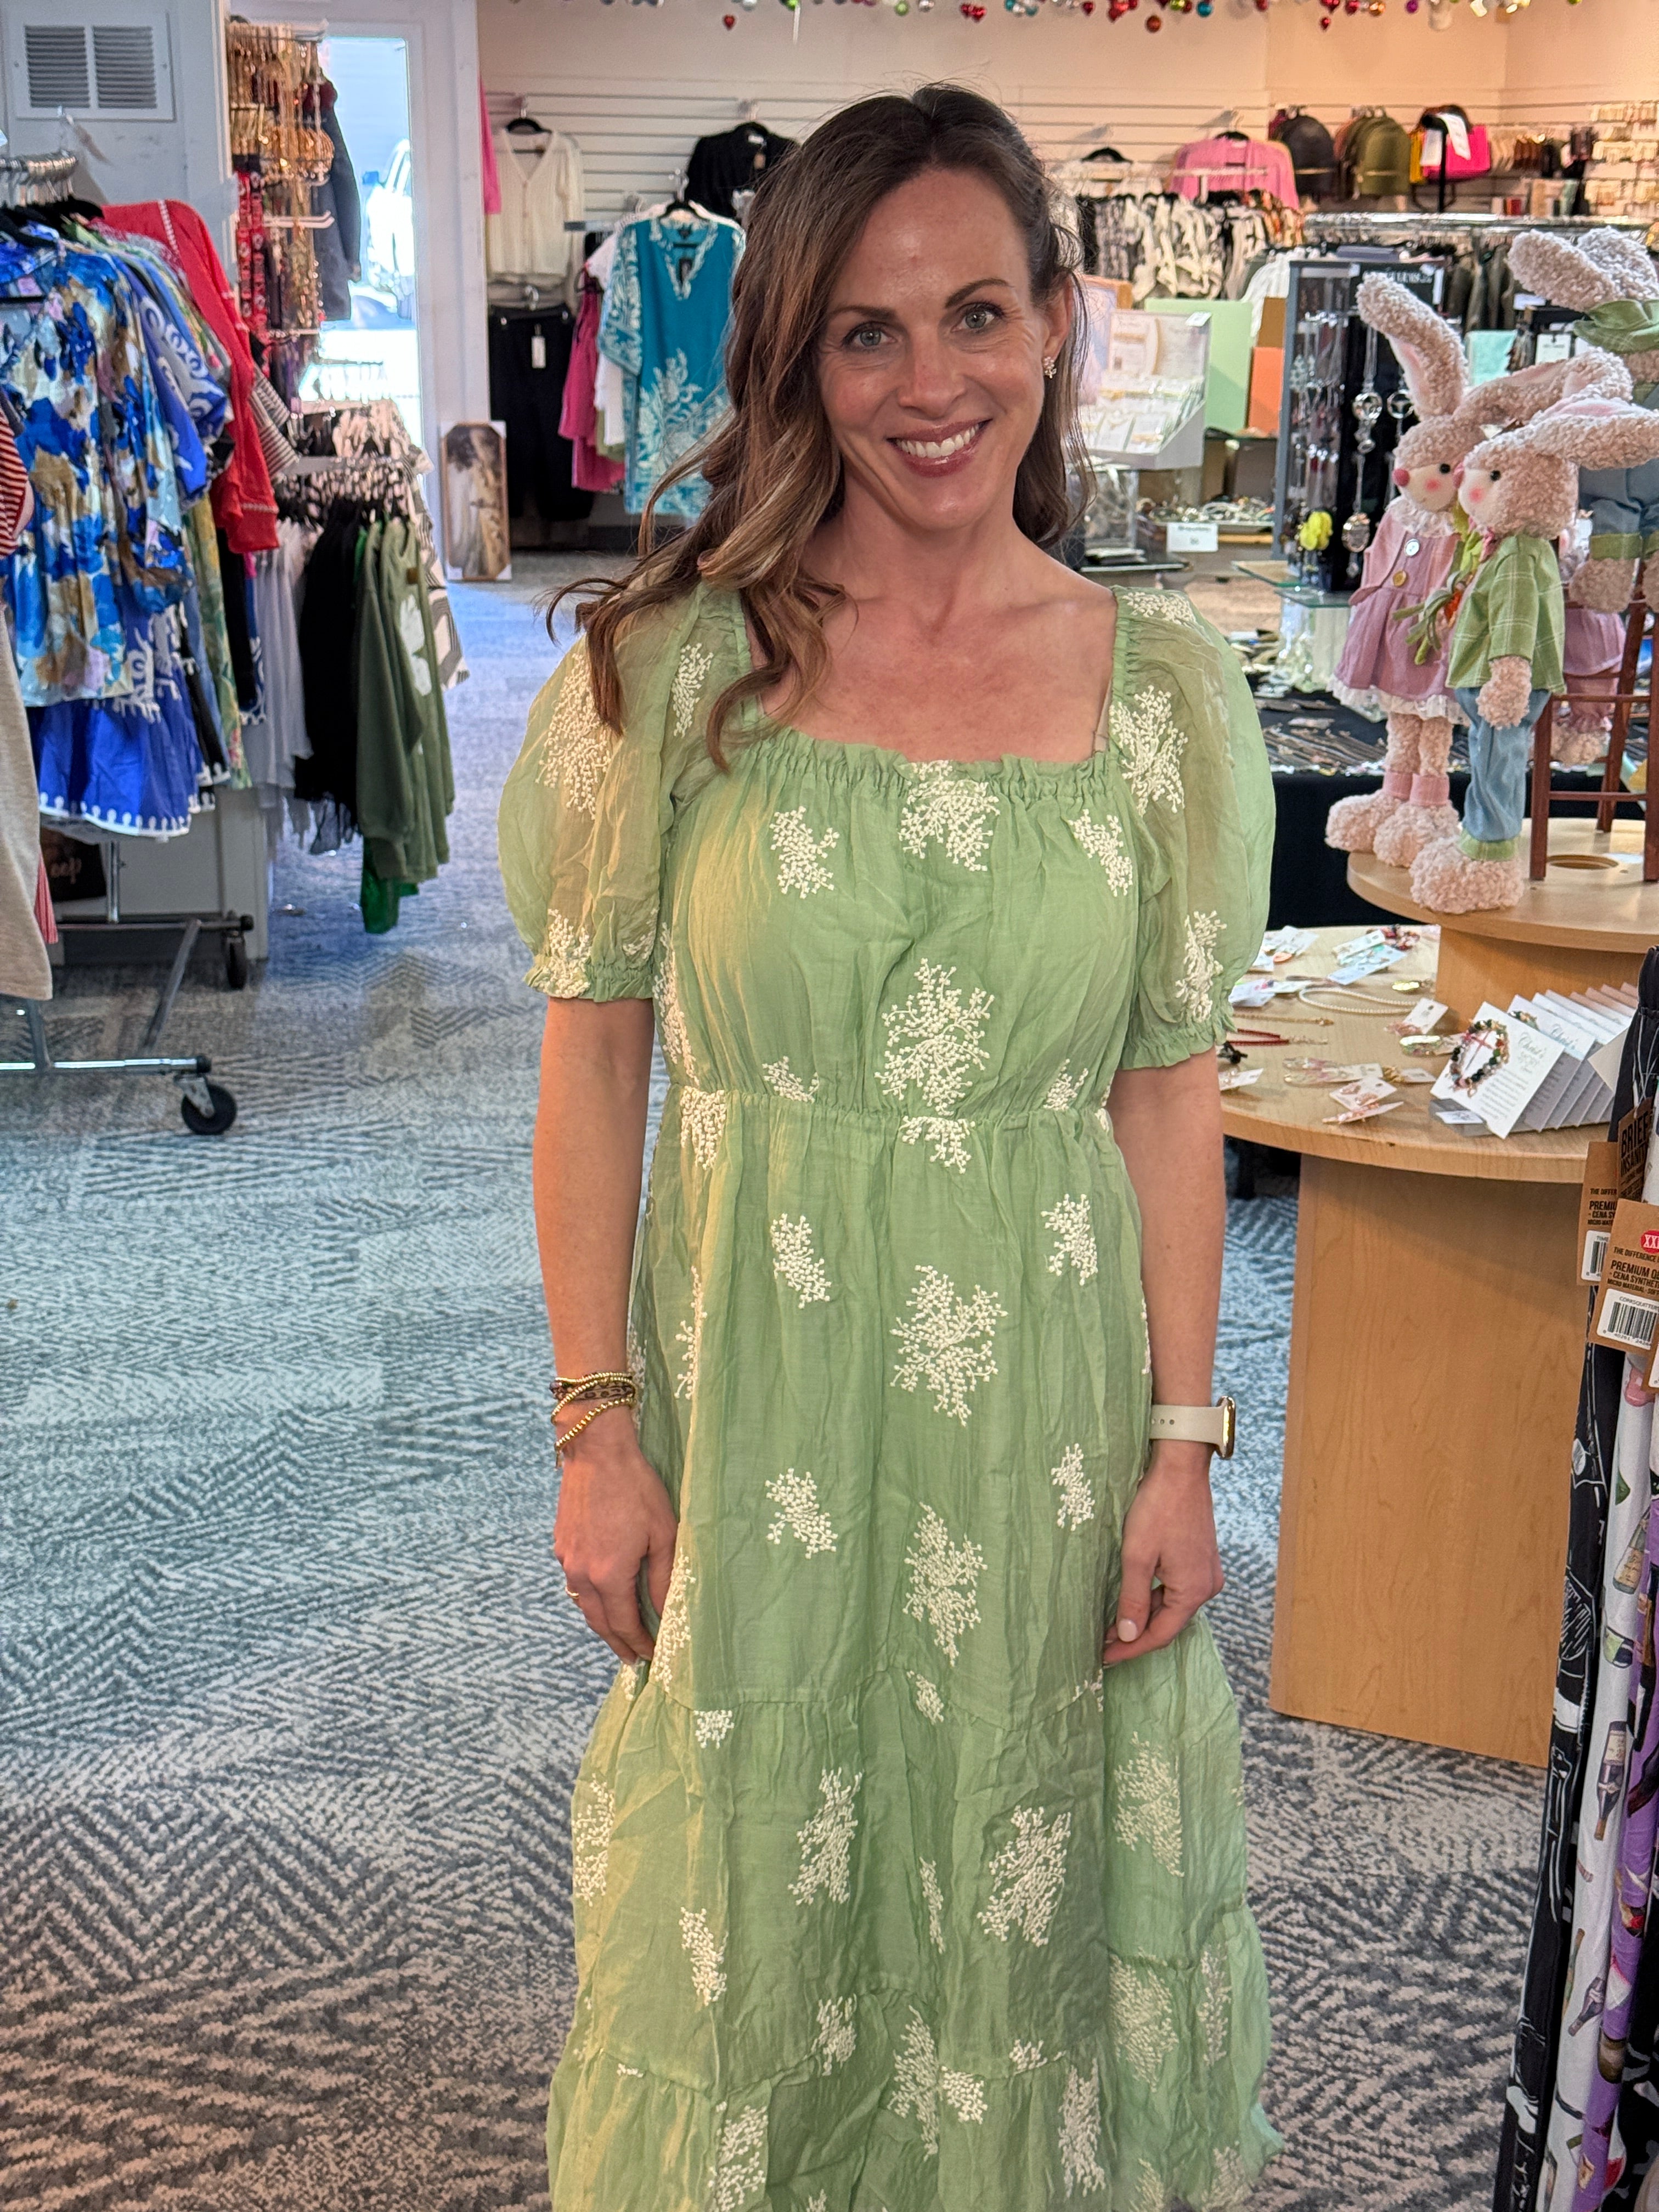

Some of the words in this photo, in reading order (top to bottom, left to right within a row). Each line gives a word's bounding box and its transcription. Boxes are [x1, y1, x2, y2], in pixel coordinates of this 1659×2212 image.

[1621, 1111, 1648, 1159] BRIEF
[1592, 1210, 1607, 1218] CENA
[1614, 1246, 1624, 1255] THE
[1624, 1249, 1656, 1262] DIFFERENCE
[1611, 1260, 1650, 1277] PREMIUM
[1613, 1271, 1629, 1281] CENA
[1607, 1278, 1622, 1287] MICRO
[1622, 1282, 1645, 1293] MATERIAL
